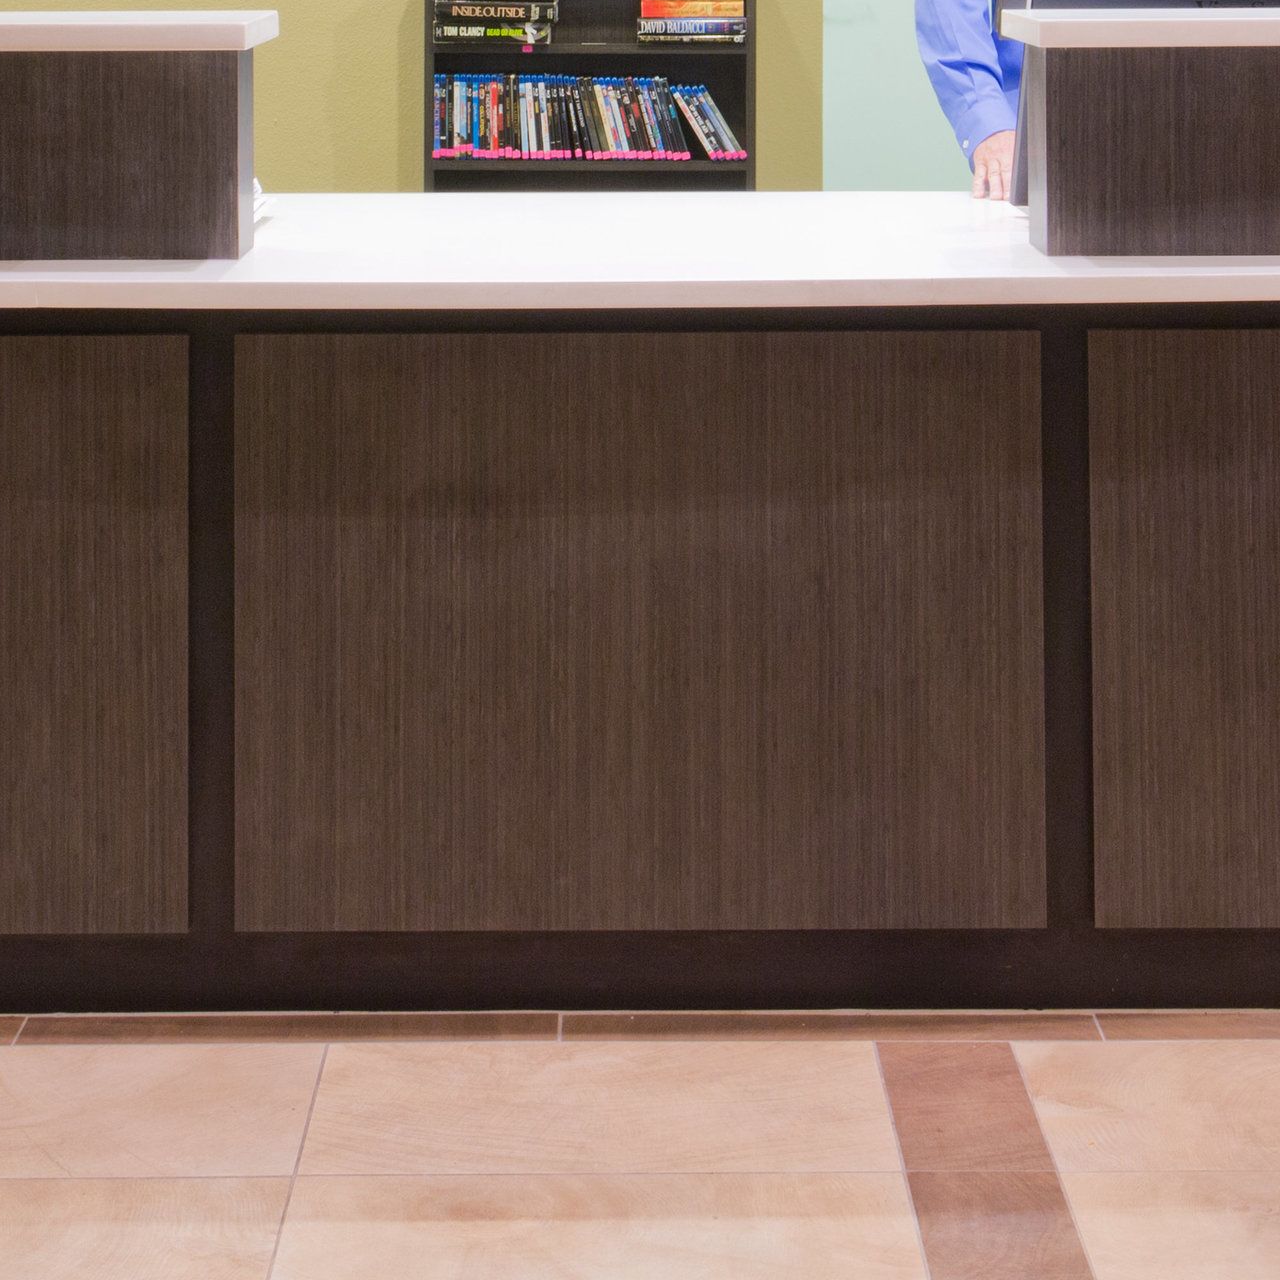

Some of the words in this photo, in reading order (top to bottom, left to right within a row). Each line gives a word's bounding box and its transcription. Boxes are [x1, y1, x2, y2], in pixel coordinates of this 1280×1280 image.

[443, 26, 458, 37] TOM
[459, 26, 486, 37] CLANCY
[640, 21, 666, 34] DAVID
[666, 21, 706, 34] BALDACCI
